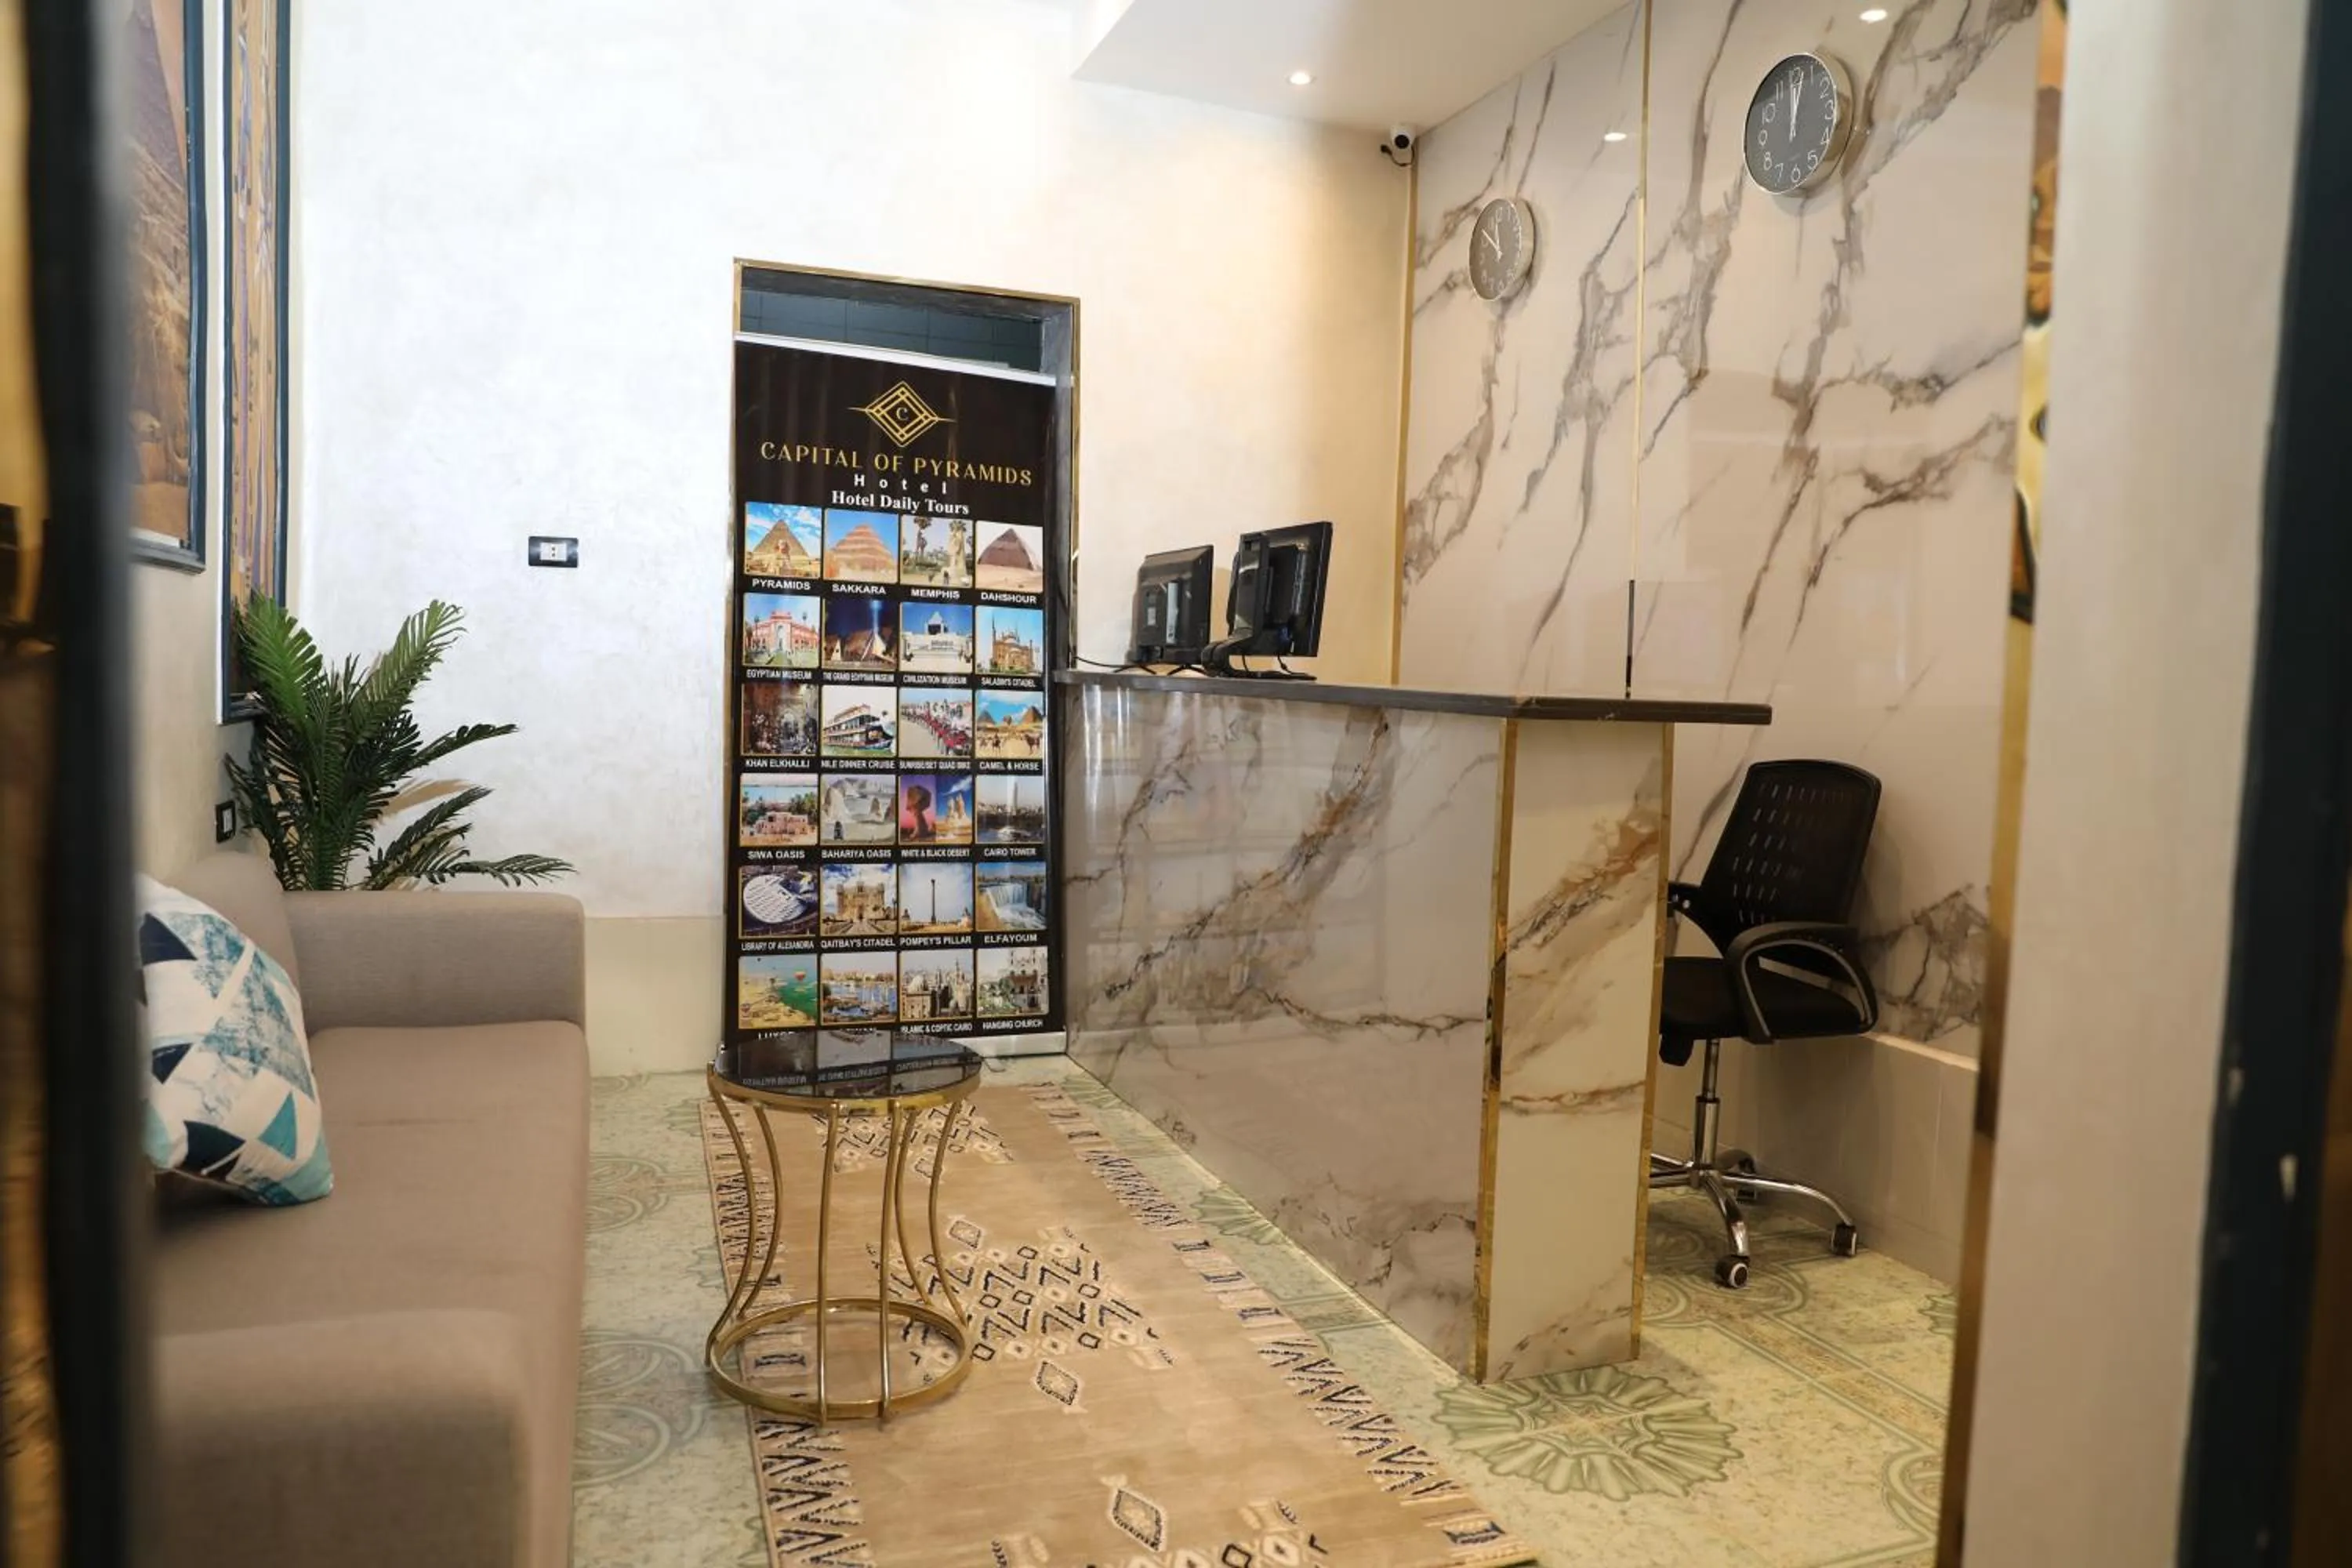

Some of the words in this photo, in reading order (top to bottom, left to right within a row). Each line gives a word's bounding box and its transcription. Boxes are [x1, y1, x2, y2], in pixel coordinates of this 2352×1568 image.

[1775, 80, 1784, 101] 11
[1819, 77, 1831, 100] 2
[1762, 103, 1776, 125] 10
[1824, 100, 1835, 120] 3
[1820, 127, 1831, 145] 4
[1762, 151, 1773, 171] 8
[1807, 150, 1819, 170] 5
[1774, 163, 1784, 183] 7
[1790, 164, 1801, 183] 6
[896, 407, 909, 422] C
[760, 441, 863, 469] CAPITAL
[874, 453, 904, 472] OF
[913, 457, 1033, 487] PYRAMIDS
[831, 490, 874, 507] Hotel
[880, 495, 920, 514] Daily
[925, 498, 969, 515] Tours
[752, 579, 811, 590] PYRAMIDS
[832, 583, 887, 594] SAKKARA
[910, 589, 960, 600] MEMPHIS
[981, 592, 1037, 604] DAHSHOUR
[746, 669, 782, 679] EGYPTIAN
[782, 670, 812, 680] MUSEUM
[903, 675, 940, 684] CIVILIZATION
[940, 676, 967, 684] MUSEUM
[1012, 677, 1036, 688] CITADEL
[746, 758, 768, 768] KHAN
[821, 759, 837, 768] NILE
[838, 759, 866, 769] DINNER
[868, 759, 895, 769] CRUISE
[980, 761, 1005, 771] CAMEL
[1014, 761, 1040, 771] HORSE
[748, 850, 773, 859] SIWA
[775, 850, 805, 859] OASIS
[822, 849, 864, 858] BAHARIYA
[866, 849, 891, 858] OASIS
[902, 848, 920, 858] WHITE
[927, 848, 946, 857] BLACK
[947, 848, 970, 857] DESERT
[984, 848, 1008, 857] CAIRO
[1010, 848, 1036, 856] TOWER
[822, 938, 862, 949] QAITBAY'S
[863, 938, 895, 947] CITADEL
[900, 936, 942, 946] POMPEY'S
[943, 935, 971, 945] PILLAR
[984, 934, 1037, 943] ELFAYOUM
[741, 942, 767, 951] LIBRARY
[768, 941, 776, 950] OF
[931, 1023, 953, 1033] COPTIC
[954, 1022, 973, 1032] CAIRO
[982, 1020, 1013, 1029] HANGING
[1014, 1018, 1044, 1028] CHURCH
